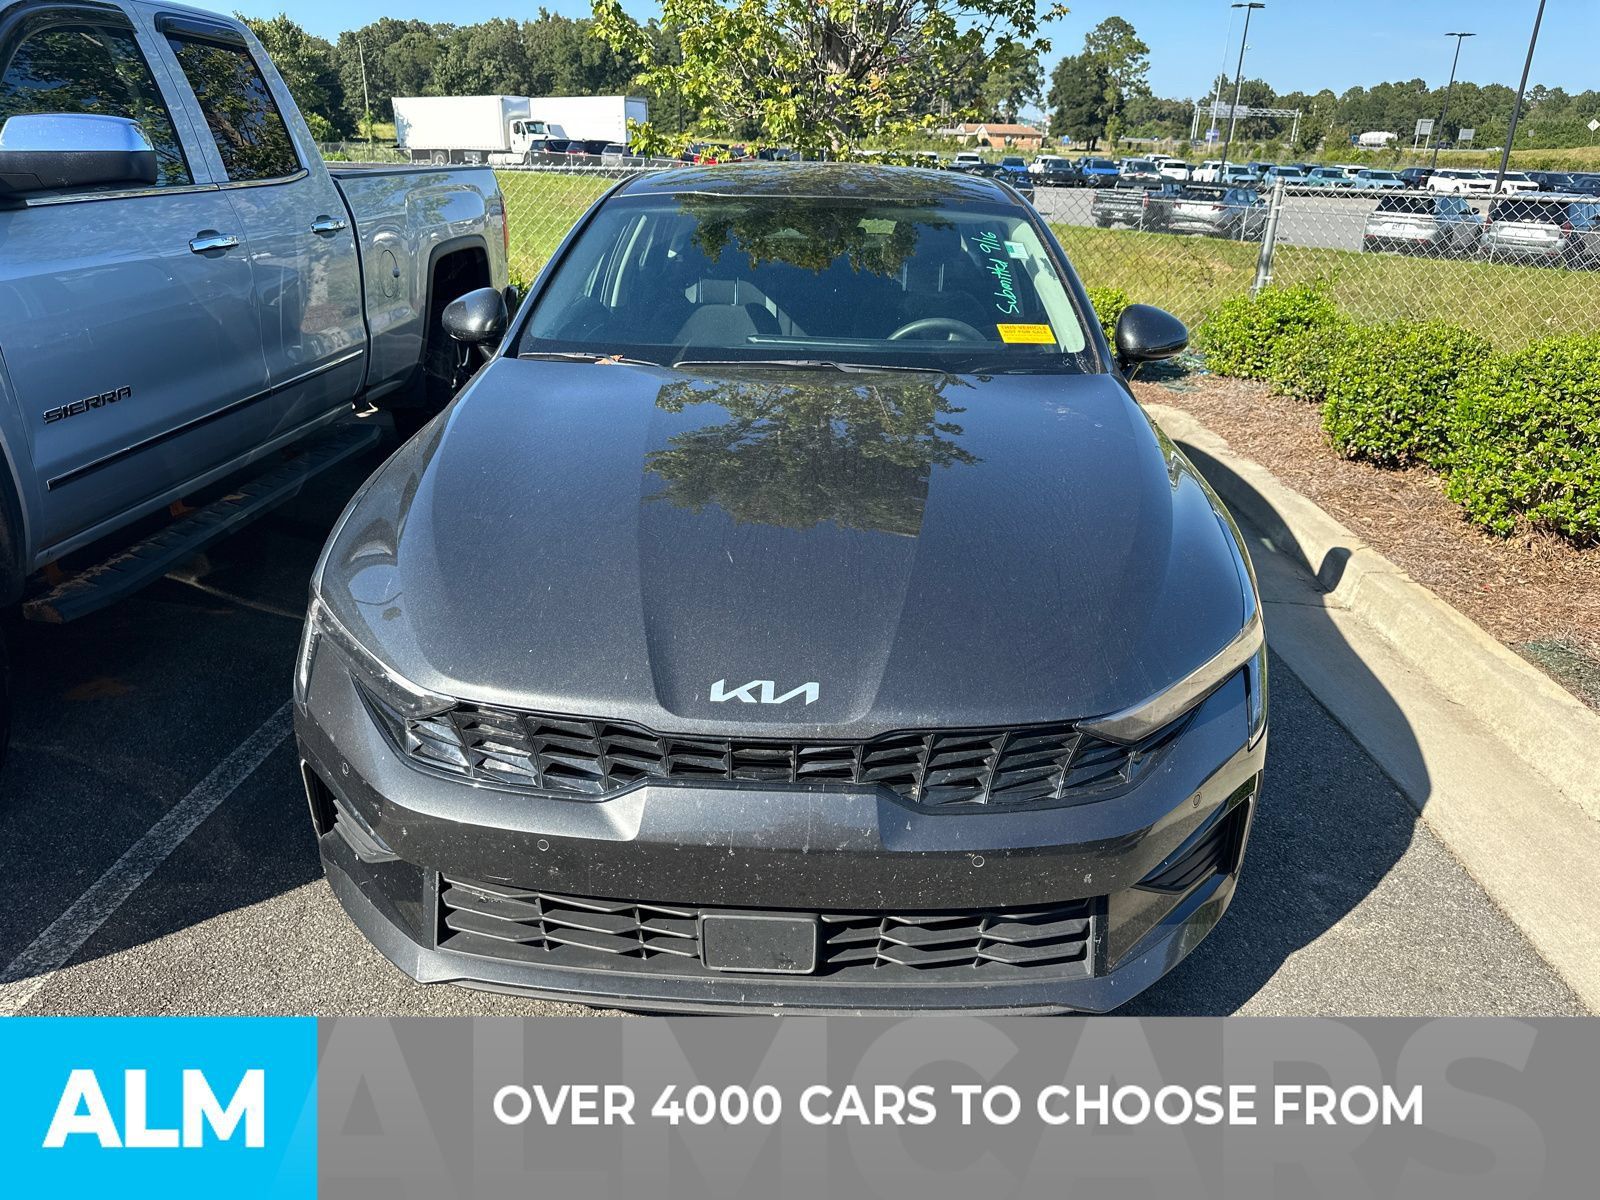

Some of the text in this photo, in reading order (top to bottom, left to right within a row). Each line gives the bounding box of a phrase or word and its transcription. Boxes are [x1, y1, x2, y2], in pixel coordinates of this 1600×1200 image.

[971, 231, 1001, 253] 9/16
[43, 385, 132, 424] SIERRA
[710, 679, 820, 705] KIA
